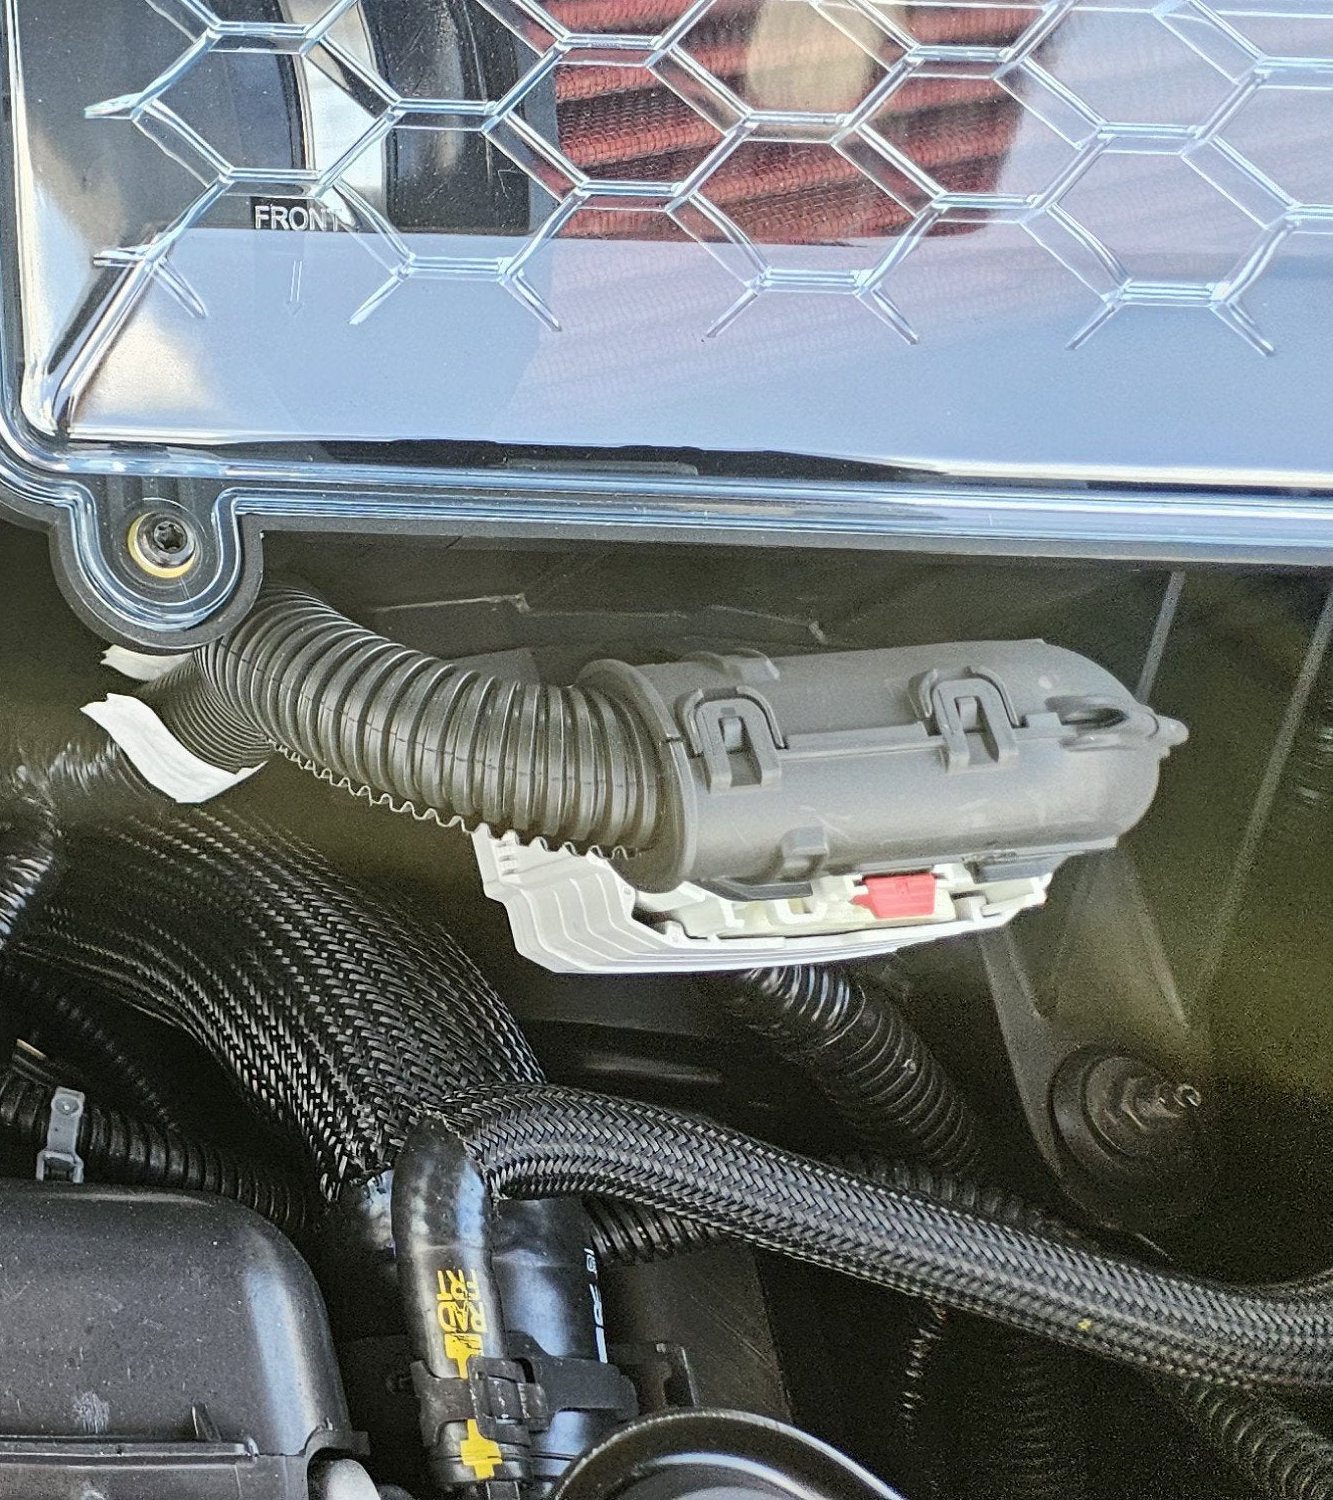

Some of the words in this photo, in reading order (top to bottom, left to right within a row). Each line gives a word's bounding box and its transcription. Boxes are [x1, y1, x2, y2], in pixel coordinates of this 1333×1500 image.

[254, 204, 342, 232] FRONT
[436, 1268, 481, 1301] FRT
[437, 1300, 487, 1332] RAD
